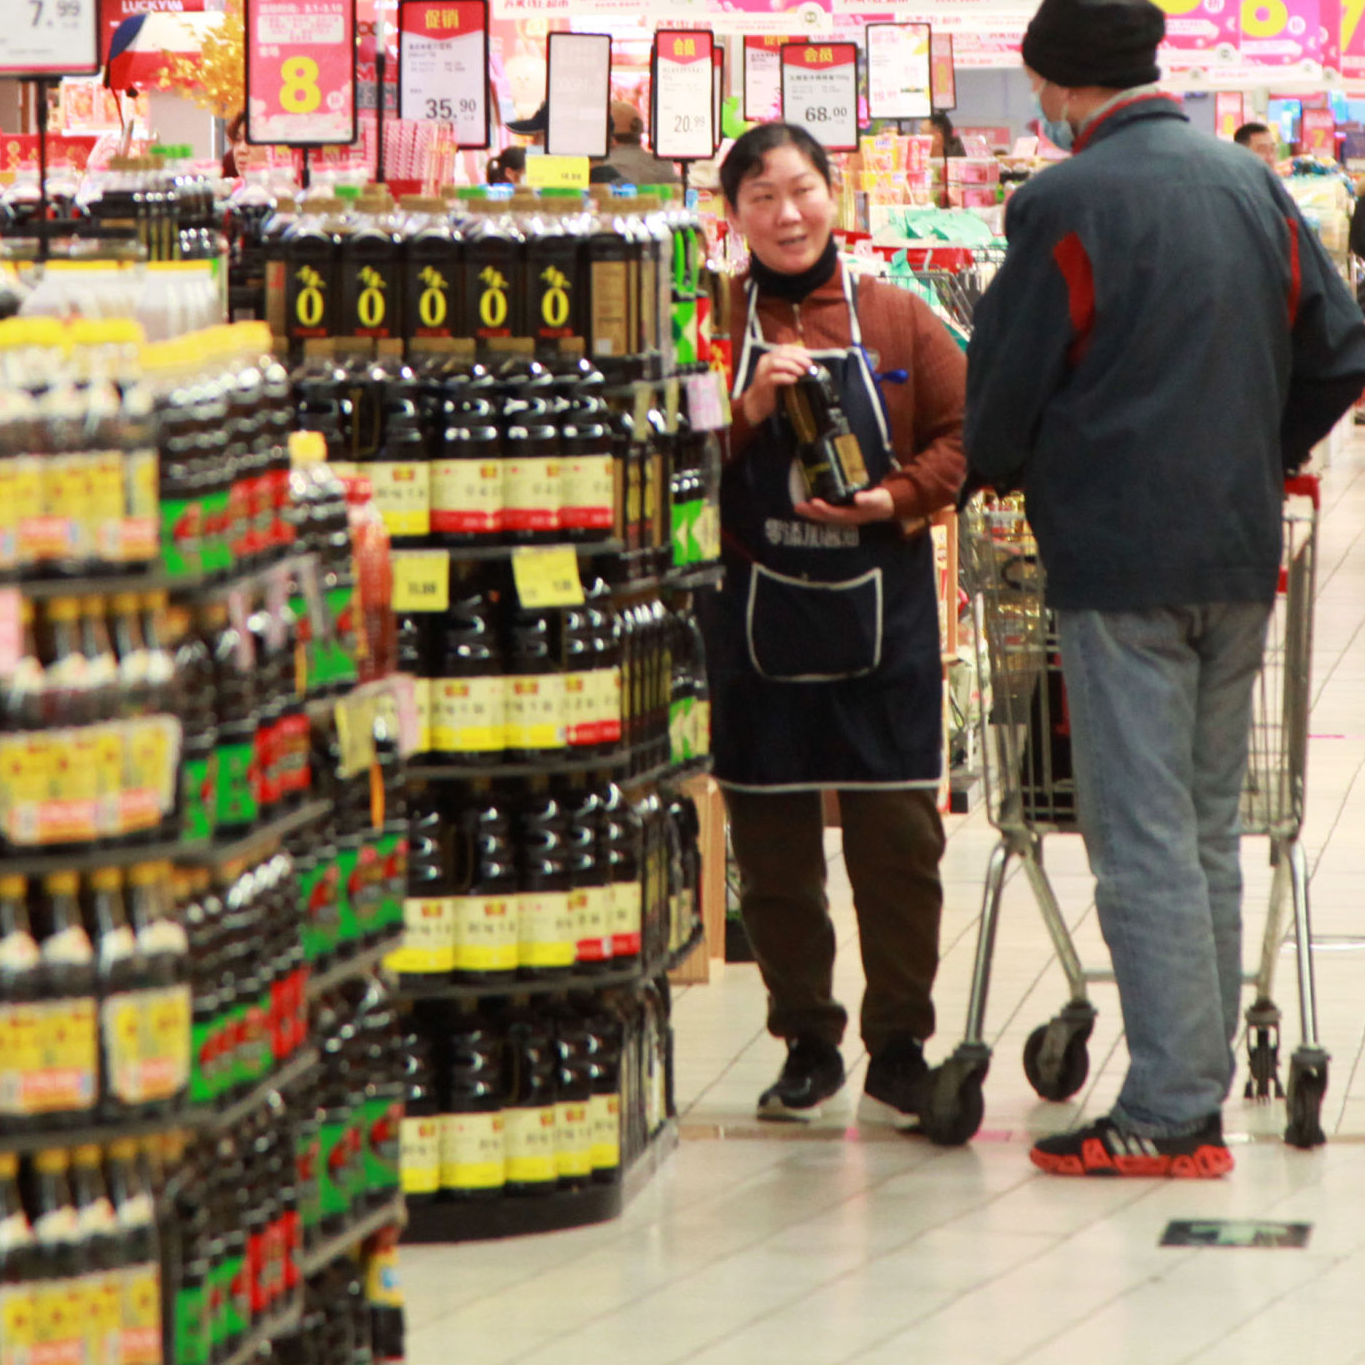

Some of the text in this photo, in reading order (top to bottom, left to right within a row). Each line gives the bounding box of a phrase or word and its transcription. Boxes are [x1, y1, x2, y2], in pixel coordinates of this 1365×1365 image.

[424, 8, 460, 30] 促销
[803, 47, 834, 63] 会员
[278, 55, 322, 115] 8
[425, 98, 477, 121] 35.90
[673, 114, 706, 133] 20.99
[804, 106, 848, 124] 68.00
[295, 286, 324, 328] 0
[357, 286, 385, 328] 0
[418, 286, 447, 328] 0
[479, 286, 508, 328] 0
[541, 286, 570, 328] 0
